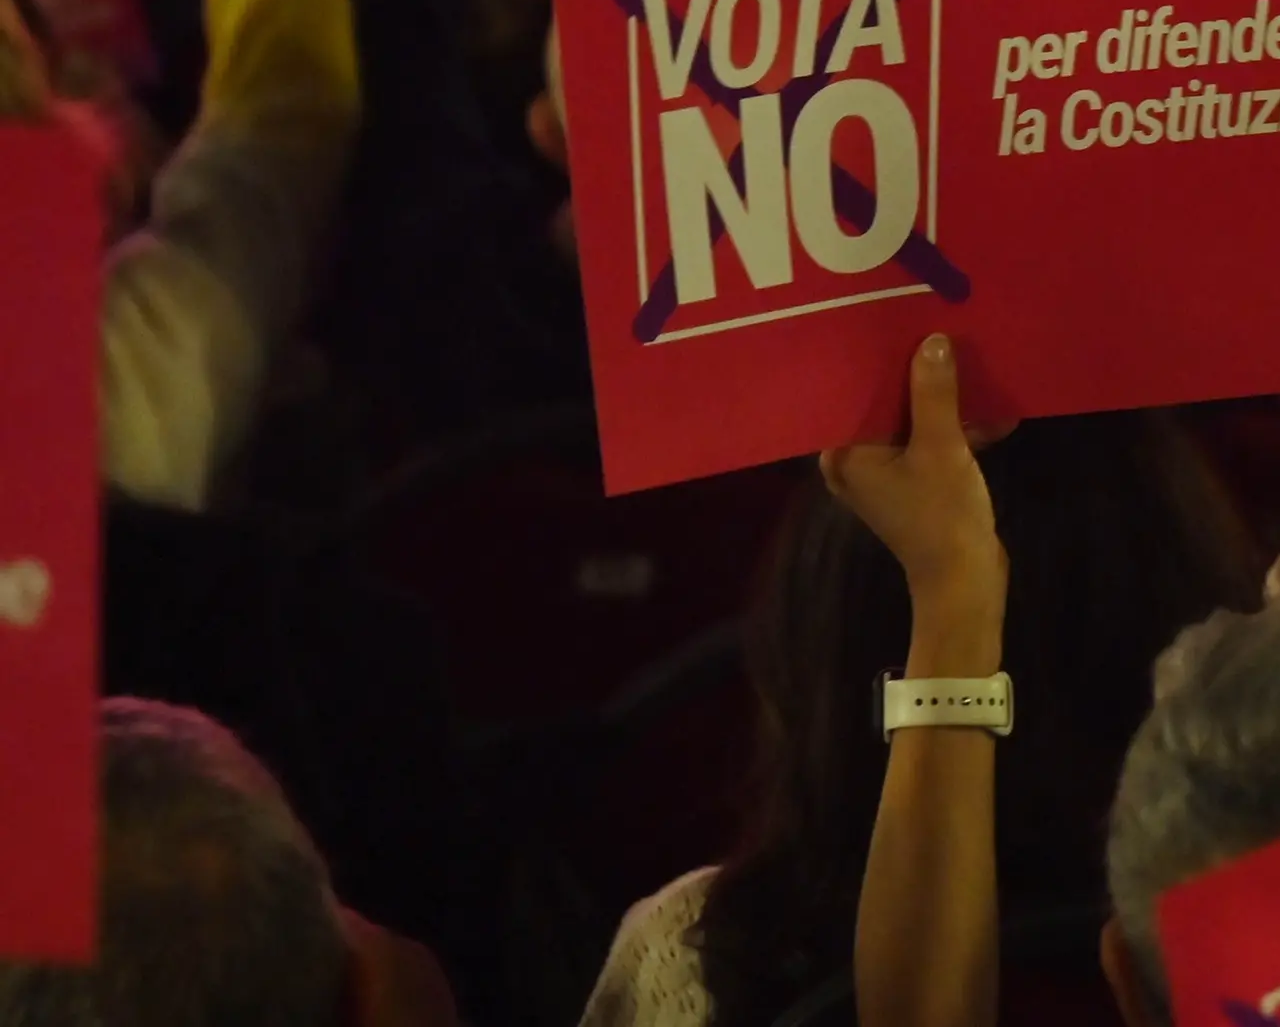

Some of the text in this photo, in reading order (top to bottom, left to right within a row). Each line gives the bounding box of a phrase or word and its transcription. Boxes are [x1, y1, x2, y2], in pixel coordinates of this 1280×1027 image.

[993, 28, 1088, 99] per
[998, 94, 1047, 156] la
[658, 78, 920, 305] NO
